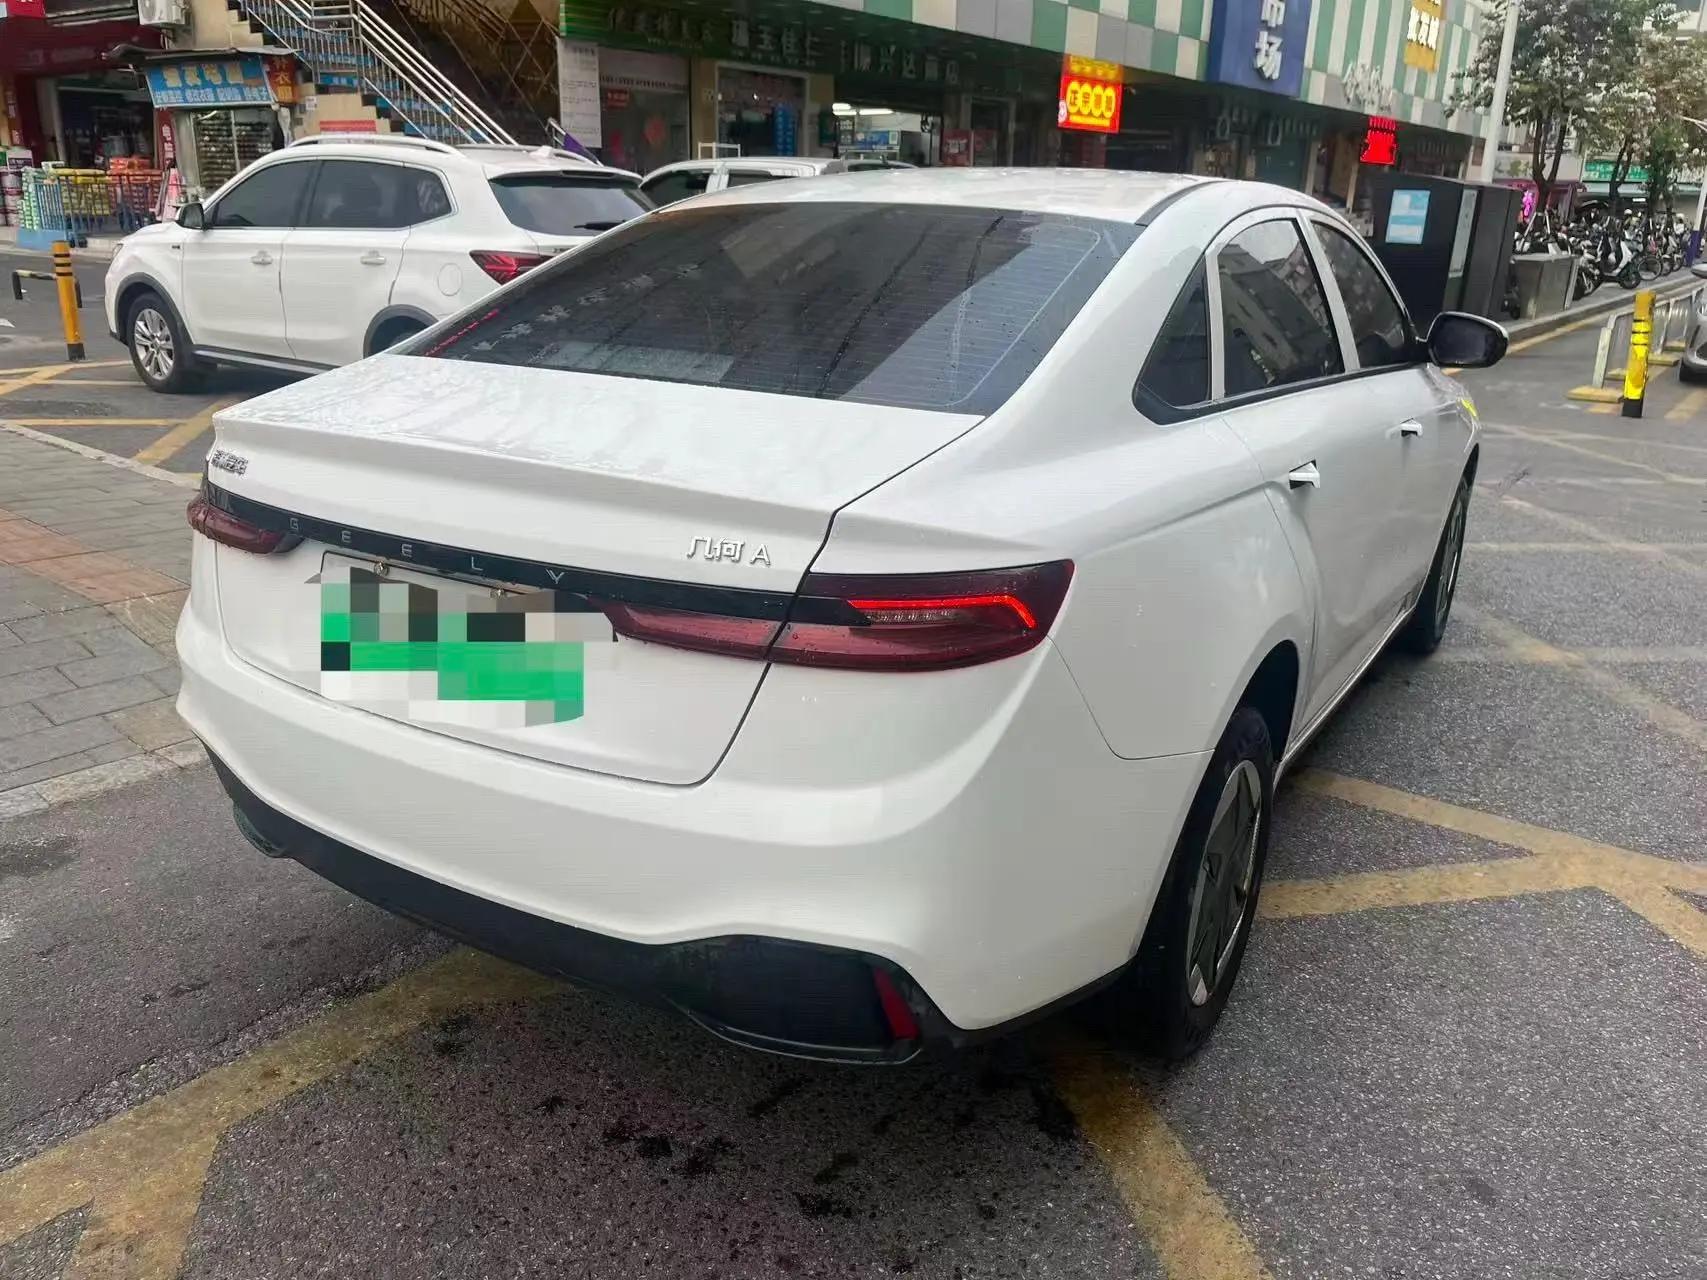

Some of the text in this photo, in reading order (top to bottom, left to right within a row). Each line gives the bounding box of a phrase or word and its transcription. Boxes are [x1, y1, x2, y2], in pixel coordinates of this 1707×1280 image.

[288, 517, 565, 585] GEELY
[686, 536, 772, 566] 几何 A
